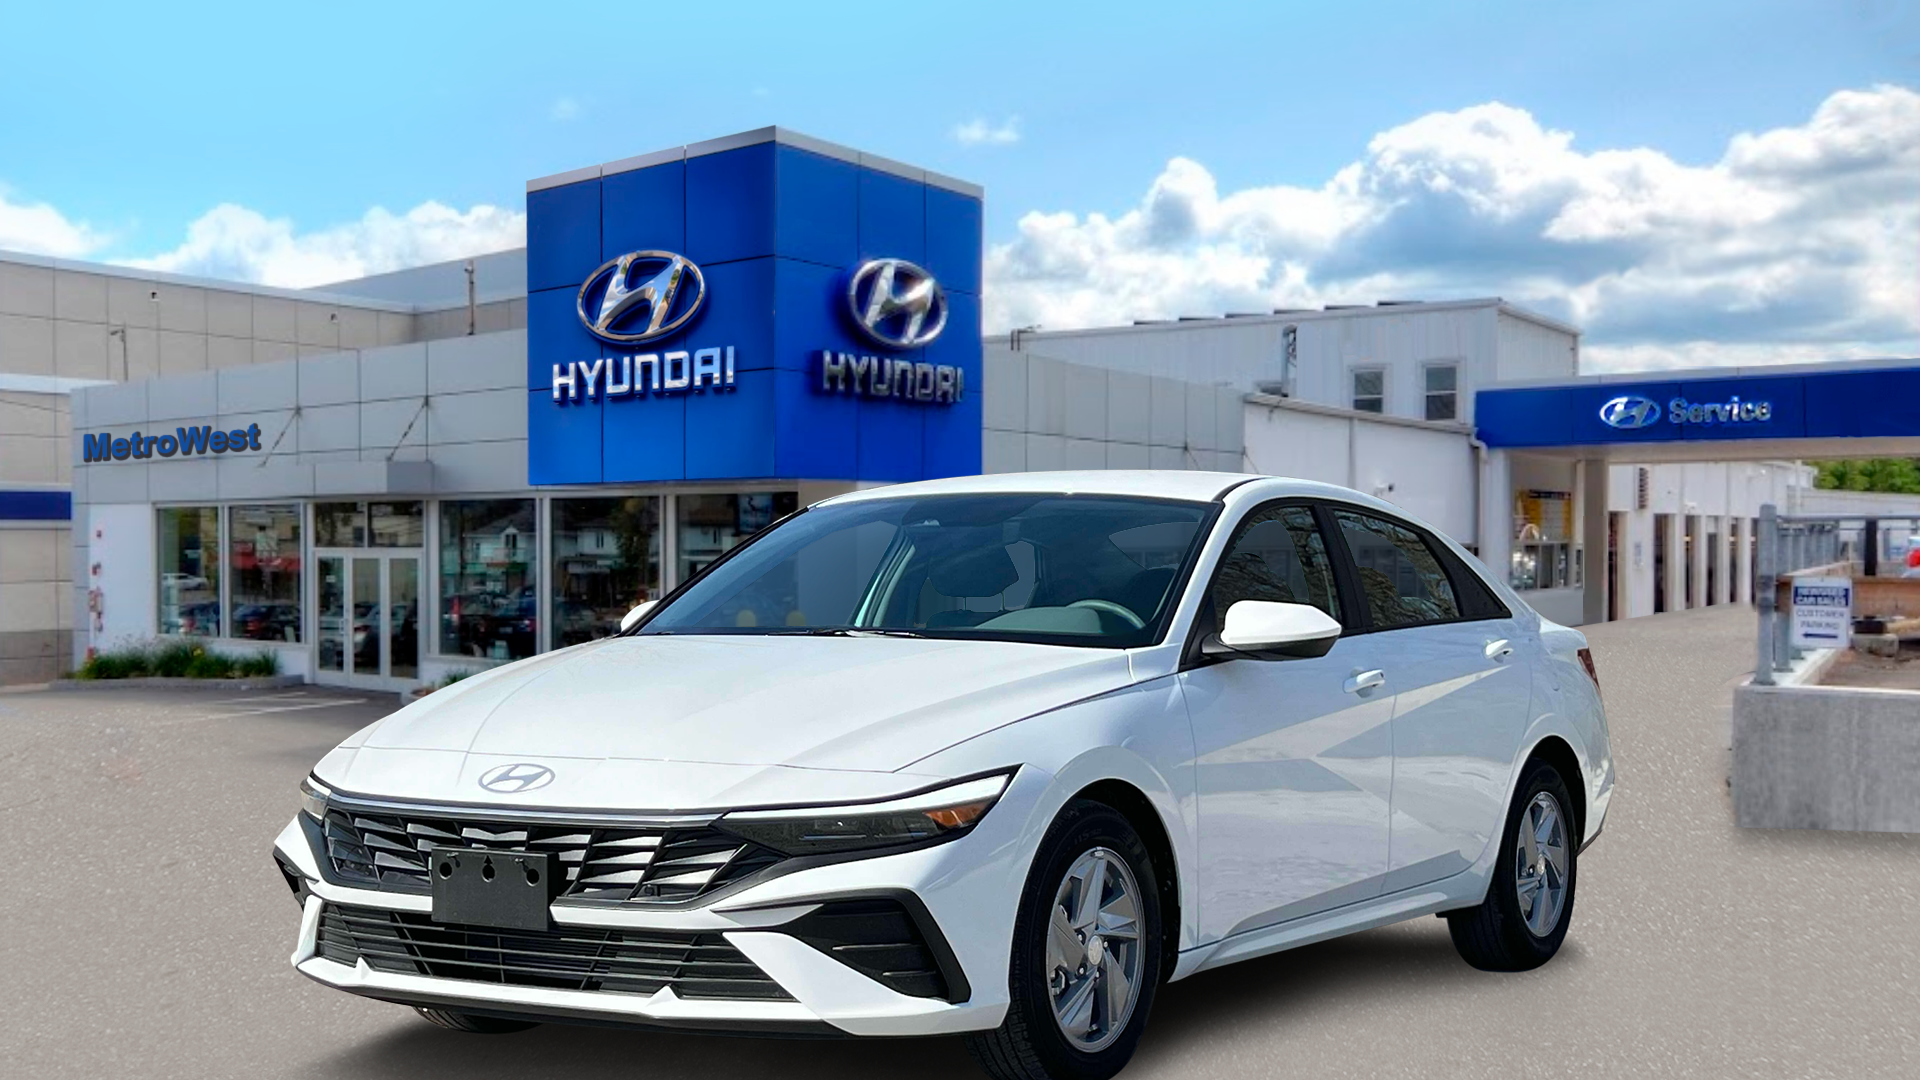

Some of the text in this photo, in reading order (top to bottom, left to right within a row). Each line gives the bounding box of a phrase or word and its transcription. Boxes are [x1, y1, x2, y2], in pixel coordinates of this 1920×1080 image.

[553, 345, 735, 402] HYUNDAI
[822, 349, 964, 404] HYUNDAI
[1669, 396, 1772, 424] Service
[83, 422, 262, 463] MetroWest
[1796, 596, 1846, 606] CAR SALES
[1796, 609, 1845, 618] CUSTOMER
[1800, 620, 1840, 630] PARKING
